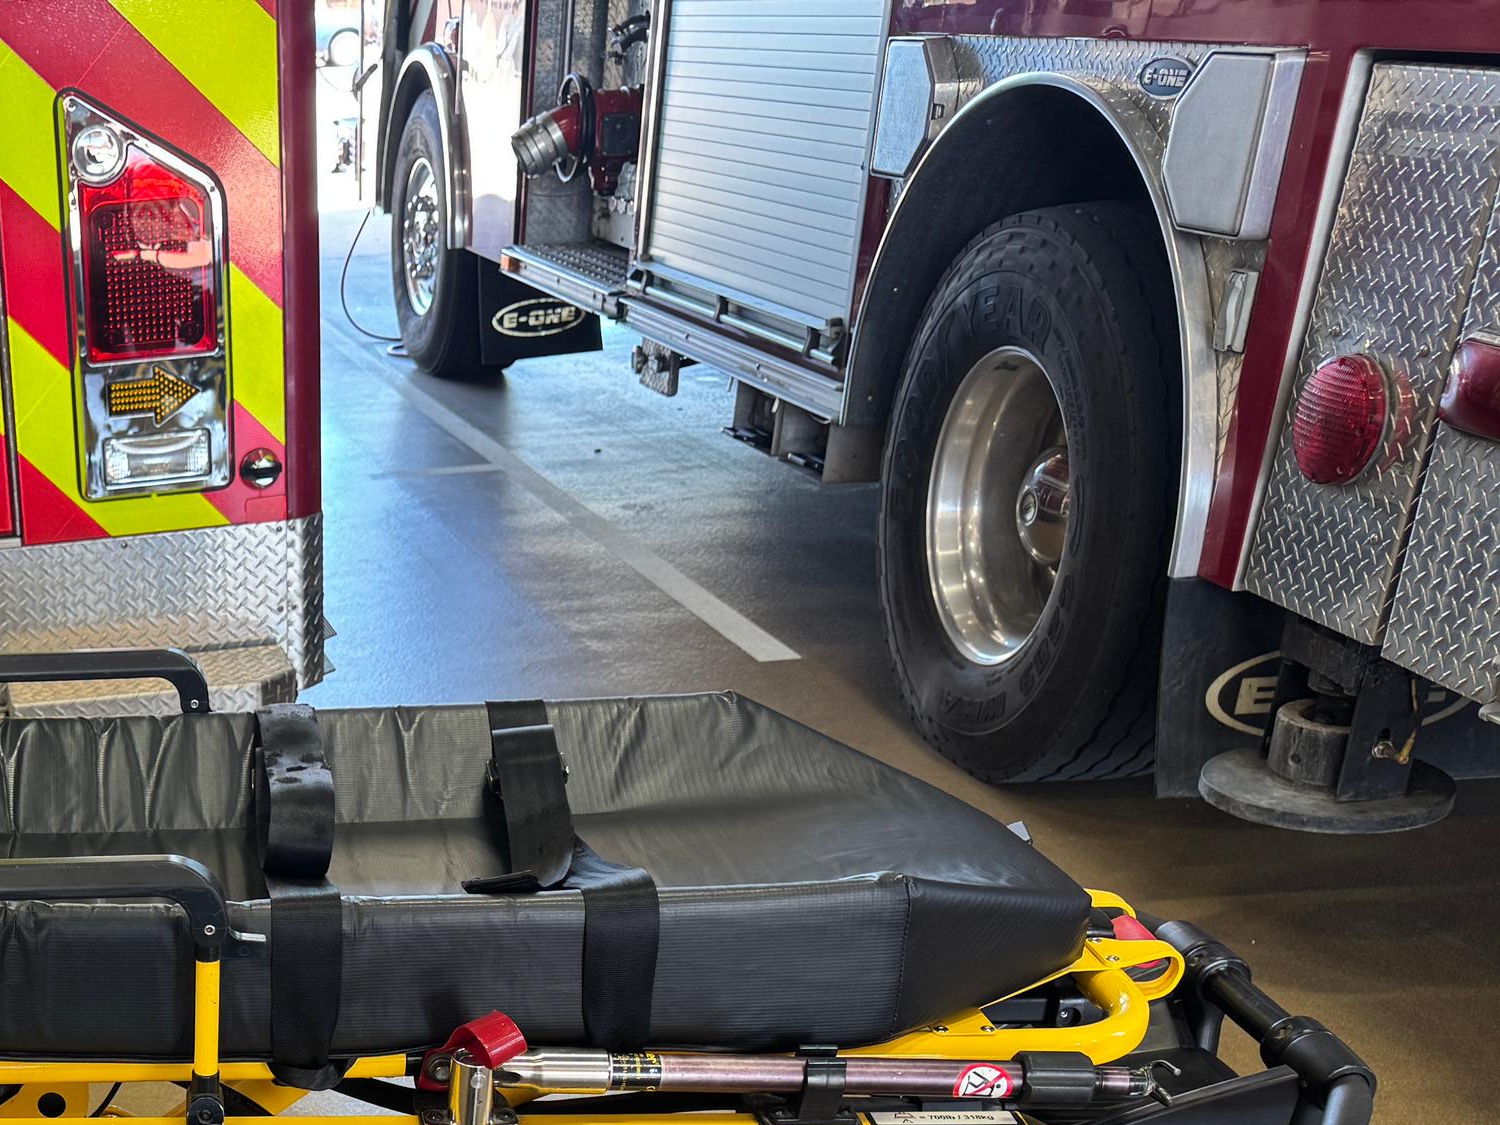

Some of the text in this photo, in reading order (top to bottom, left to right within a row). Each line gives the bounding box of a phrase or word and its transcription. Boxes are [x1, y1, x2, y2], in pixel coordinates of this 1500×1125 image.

[1143, 68, 1188, 87] E-ONE
[503, 306, 576, 329] E-ONE
[963, 1113, 995, 1121] 318kg
